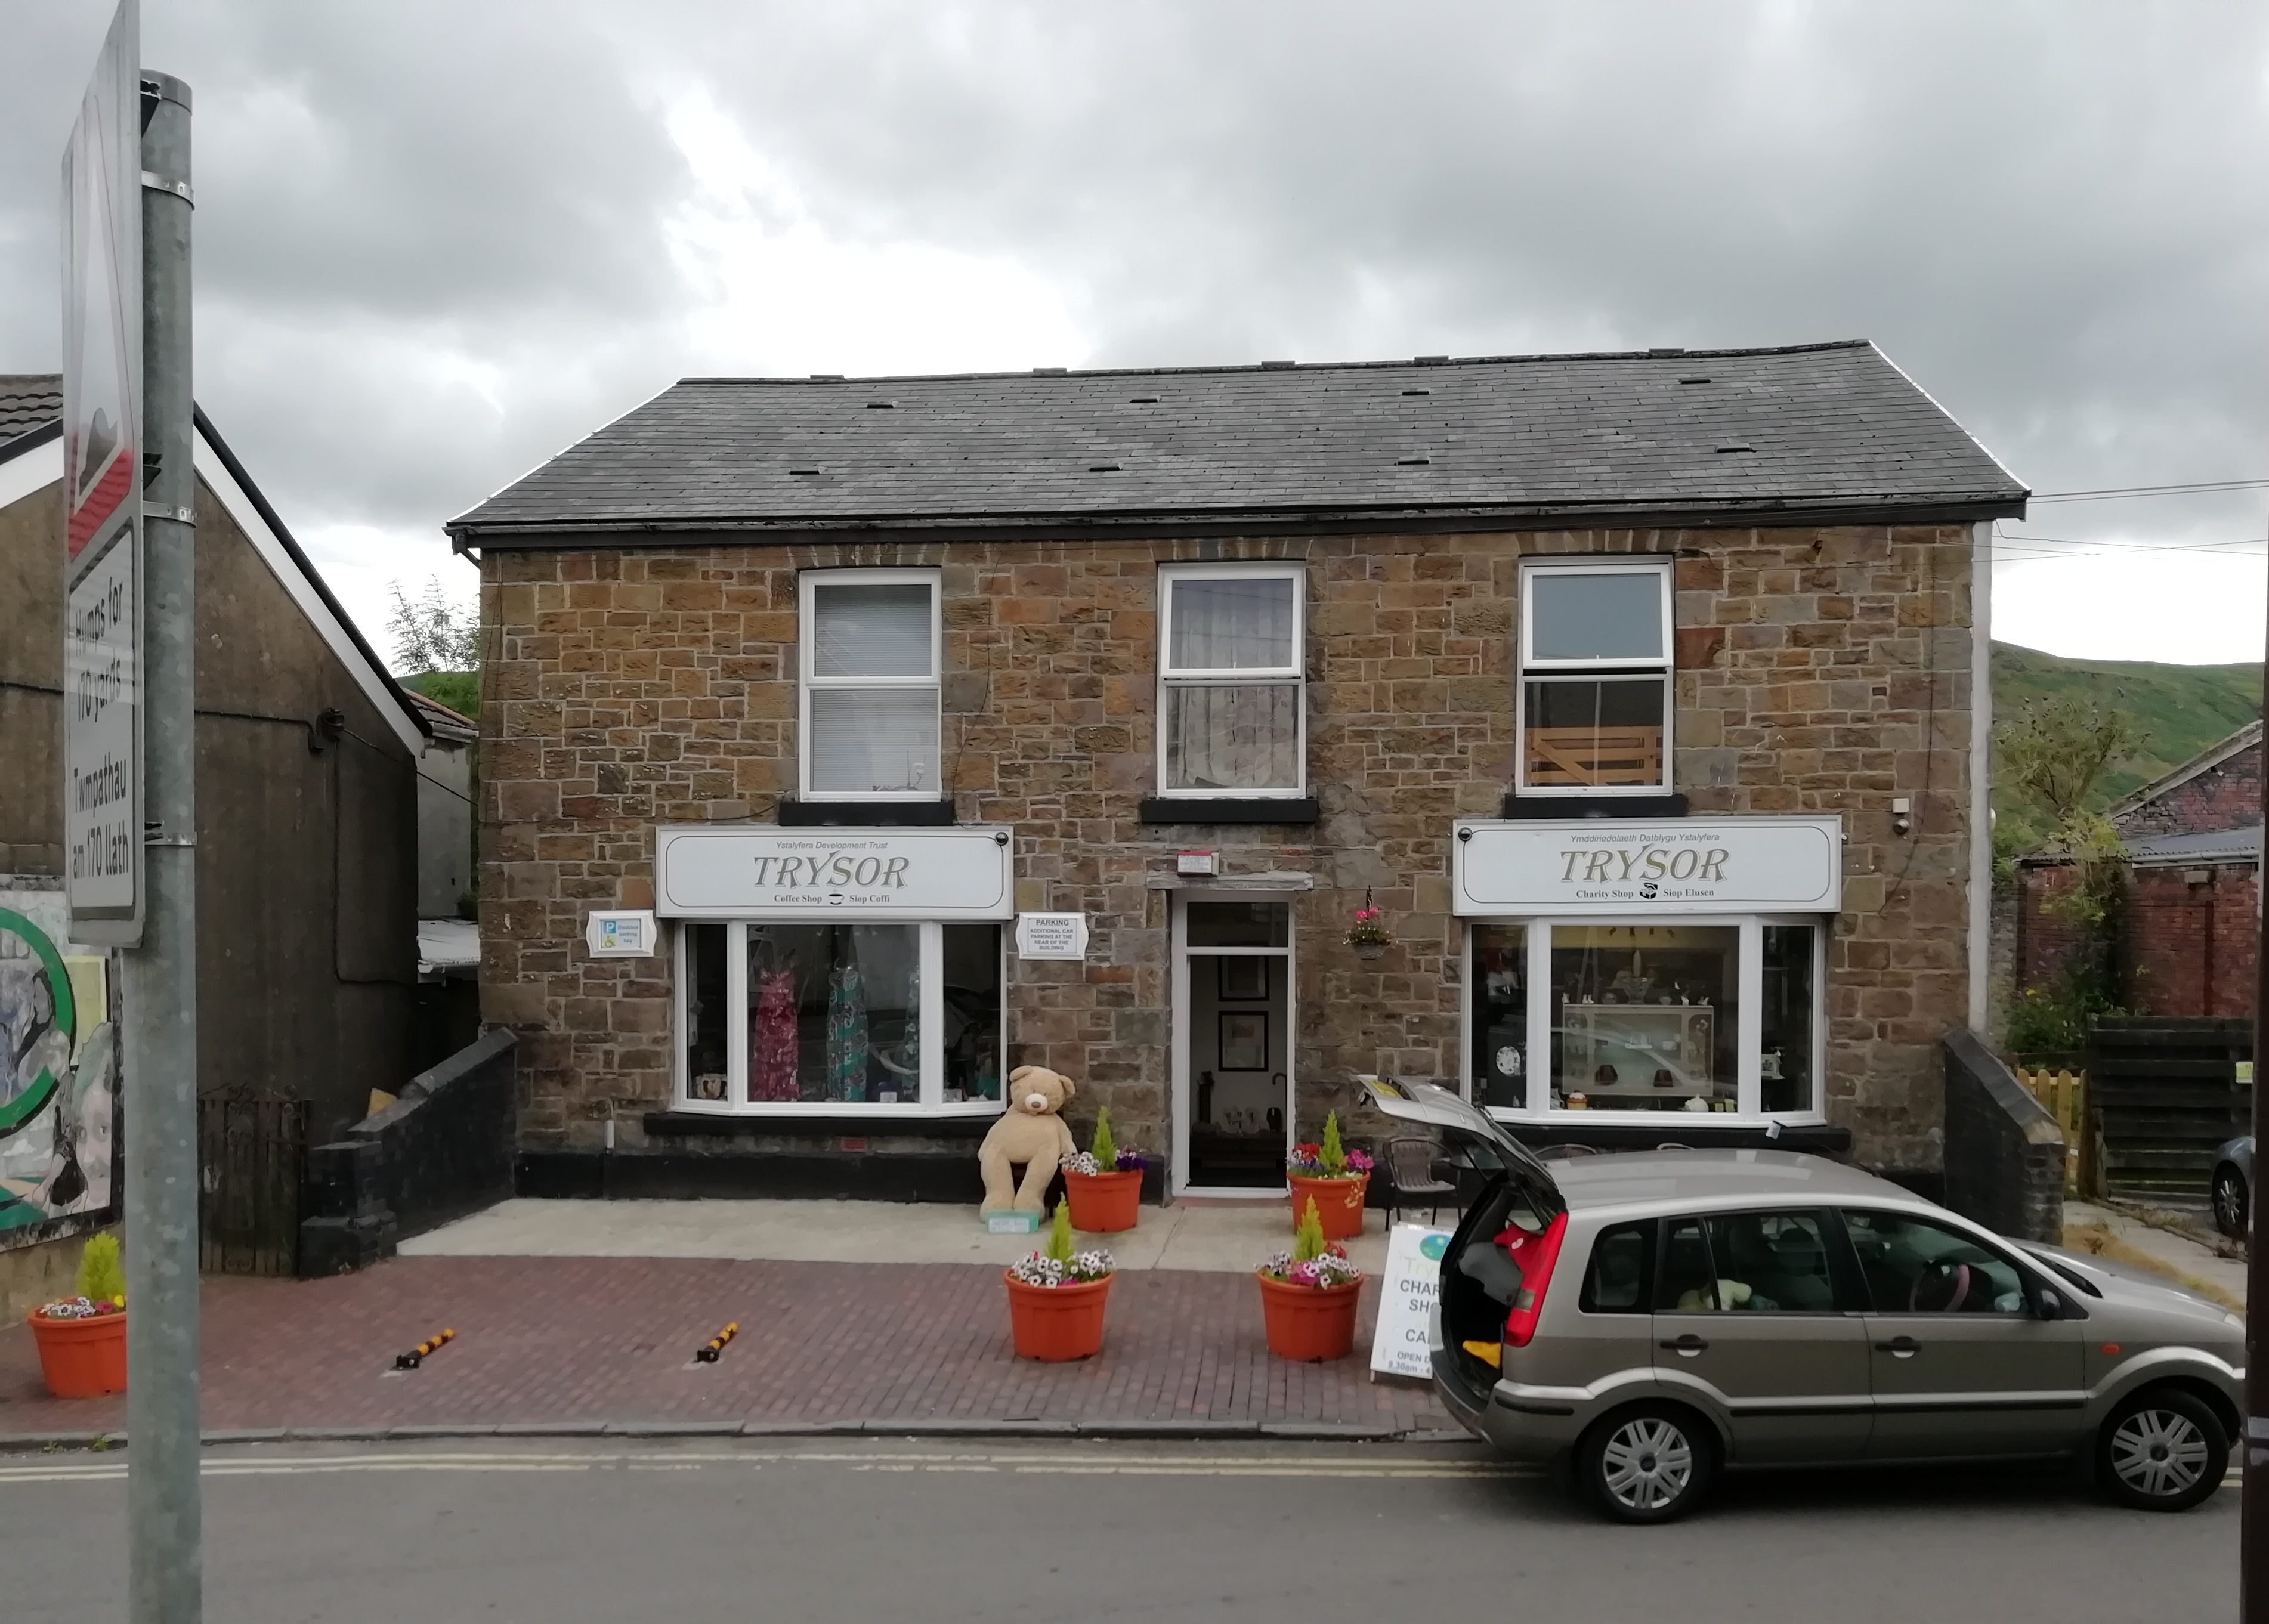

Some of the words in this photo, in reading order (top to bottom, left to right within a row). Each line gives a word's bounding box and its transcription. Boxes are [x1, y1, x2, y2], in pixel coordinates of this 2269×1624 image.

[109, 576, 123, 630] for
[78, 668, 91, 722] 170
[94, 649, 121, 723] yards
[74, 751, 126, 818] Twmpathau
[1571, 834, 1637, 843] Ymddiriedolaeth
[1639, 834, 1676, 843] Datblygu
[1679, 833, 1720, 842] Ystalyfera
[73, 844, 85, 880] am
[88, 825, 101, 877] 170
[106, 819, 128, 876] llath
[776, 842, 814, 850] Ystalyfera
[815, 842, 866, 850] Development
[754, 850, 911, 889] TRYSOR
[1560, 843, 1730, 884] TRYSOR
[802, 895, 822, 904] Shop
[849, 895, 867, 904] Siop
[1576, 890, 1610, 899] Charity
[1612, 889, 1634, 898] Shop
[1663, 889, 1683, 898] Siop
[1404, 1255, 1439, 1280] Try
[1409, 1298, 1439, 1313] SH
[1405, 1329, 1430, 1344] CA
[1397, 1351, 1422, 1362] OPEN
